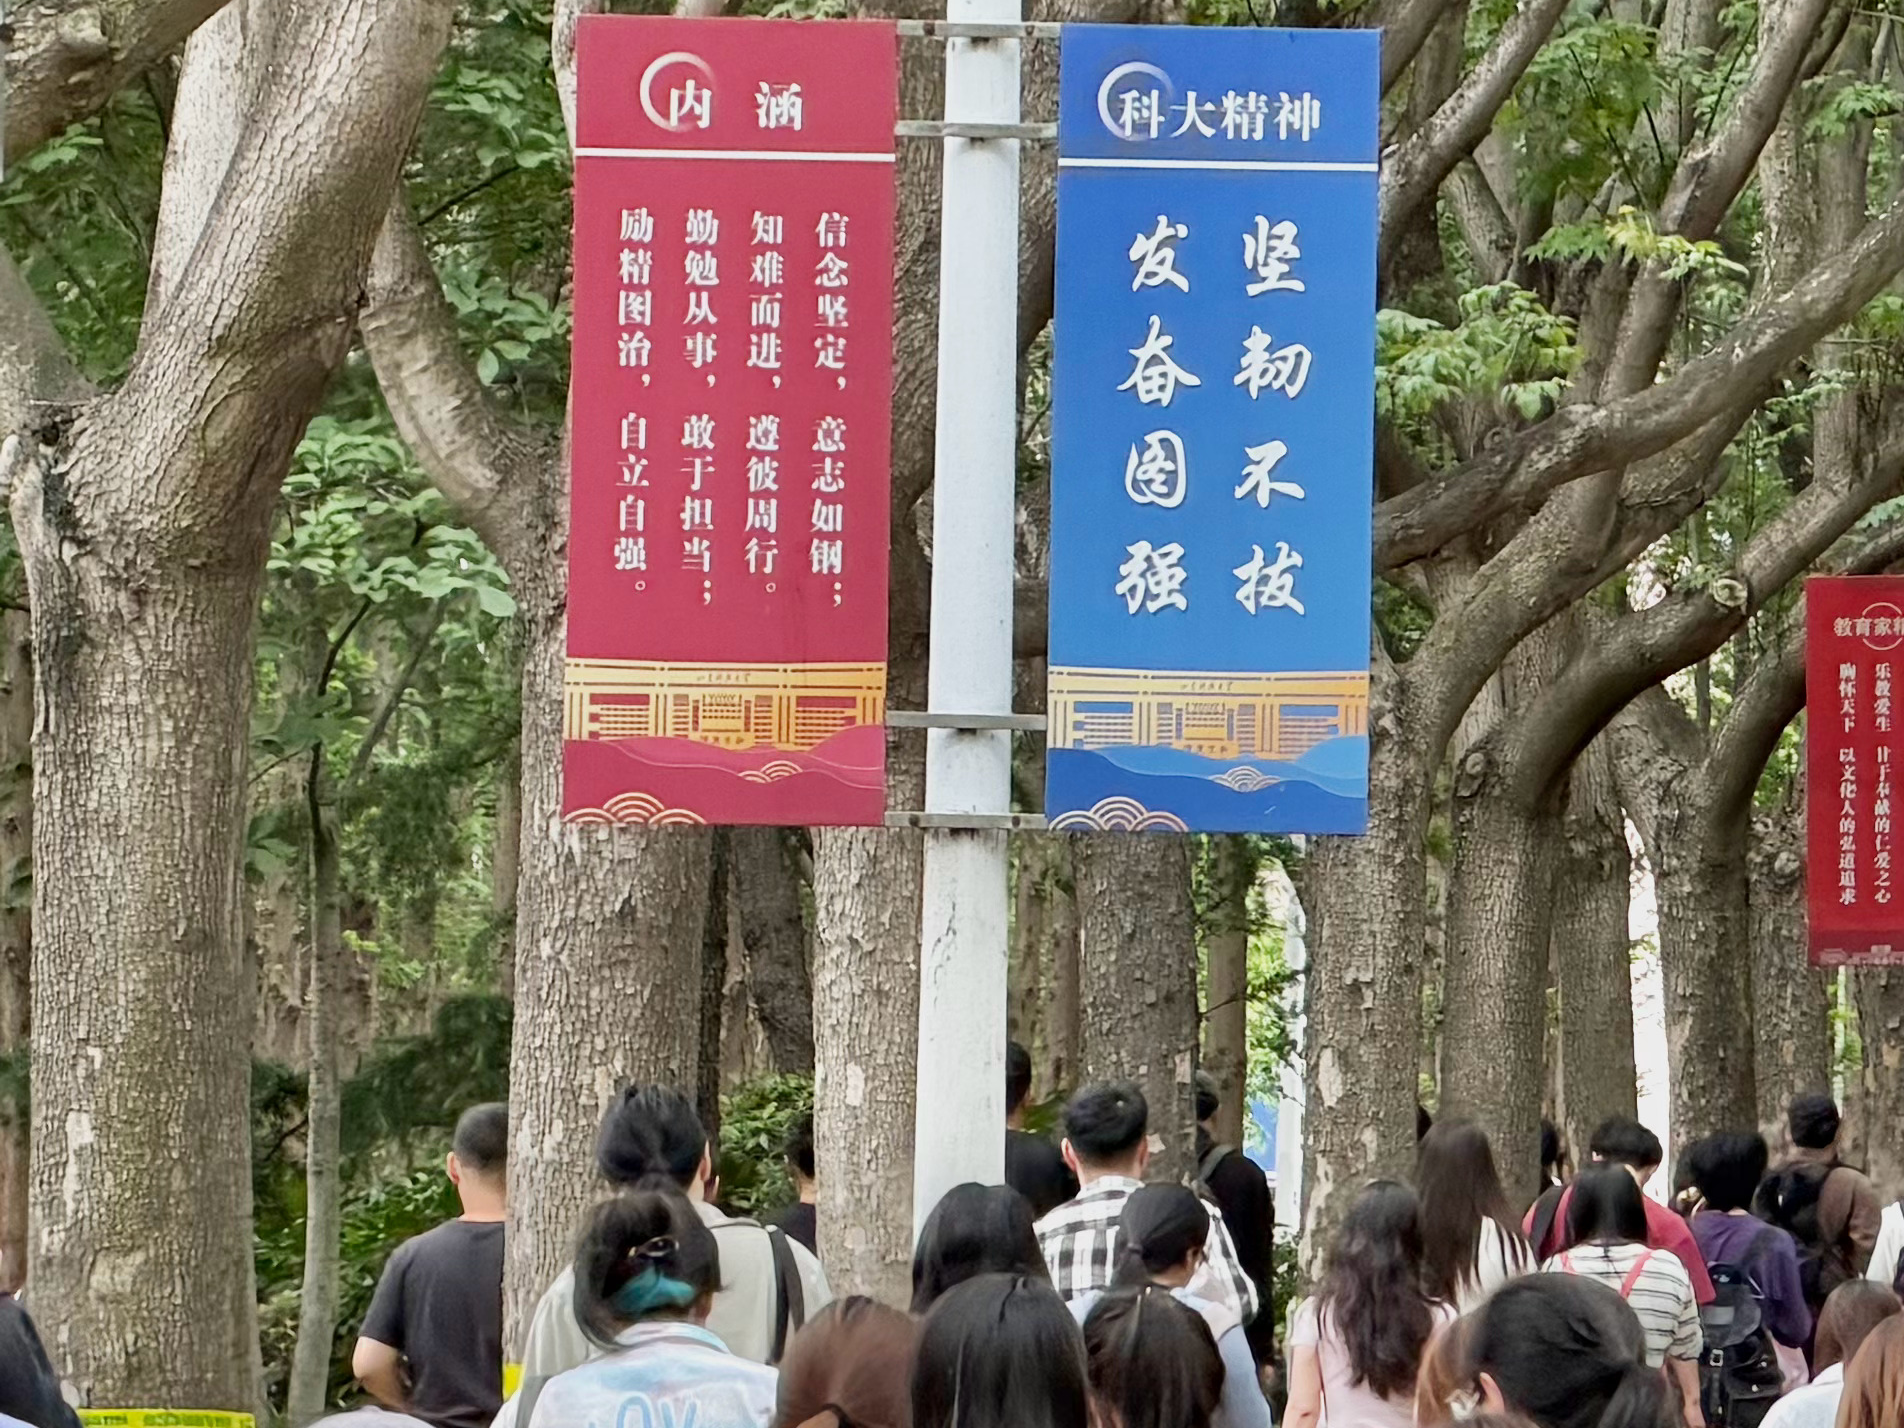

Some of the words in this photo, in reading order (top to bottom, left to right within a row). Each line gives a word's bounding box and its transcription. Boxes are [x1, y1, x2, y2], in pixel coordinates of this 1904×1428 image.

[667, 79, 803, 132] 内涵
[1117, 88, 1322, 142] 科大精神
[613, 206, 655, 592] 励精图治，自立自强。
[679, 207, 721, 606] 勤勉从事，敢于担当；
[744, 209, 785, 594] 知难而进，遵彼周行。
[808, 210, 850, 607] 信念坚定，意志如钢；
[1115, 213, 1201, 616] 发奋图强
[1232, 214, 1313, 616] 坚韧不拔
[1838, 661, 1857, 734] 胸怀天下
